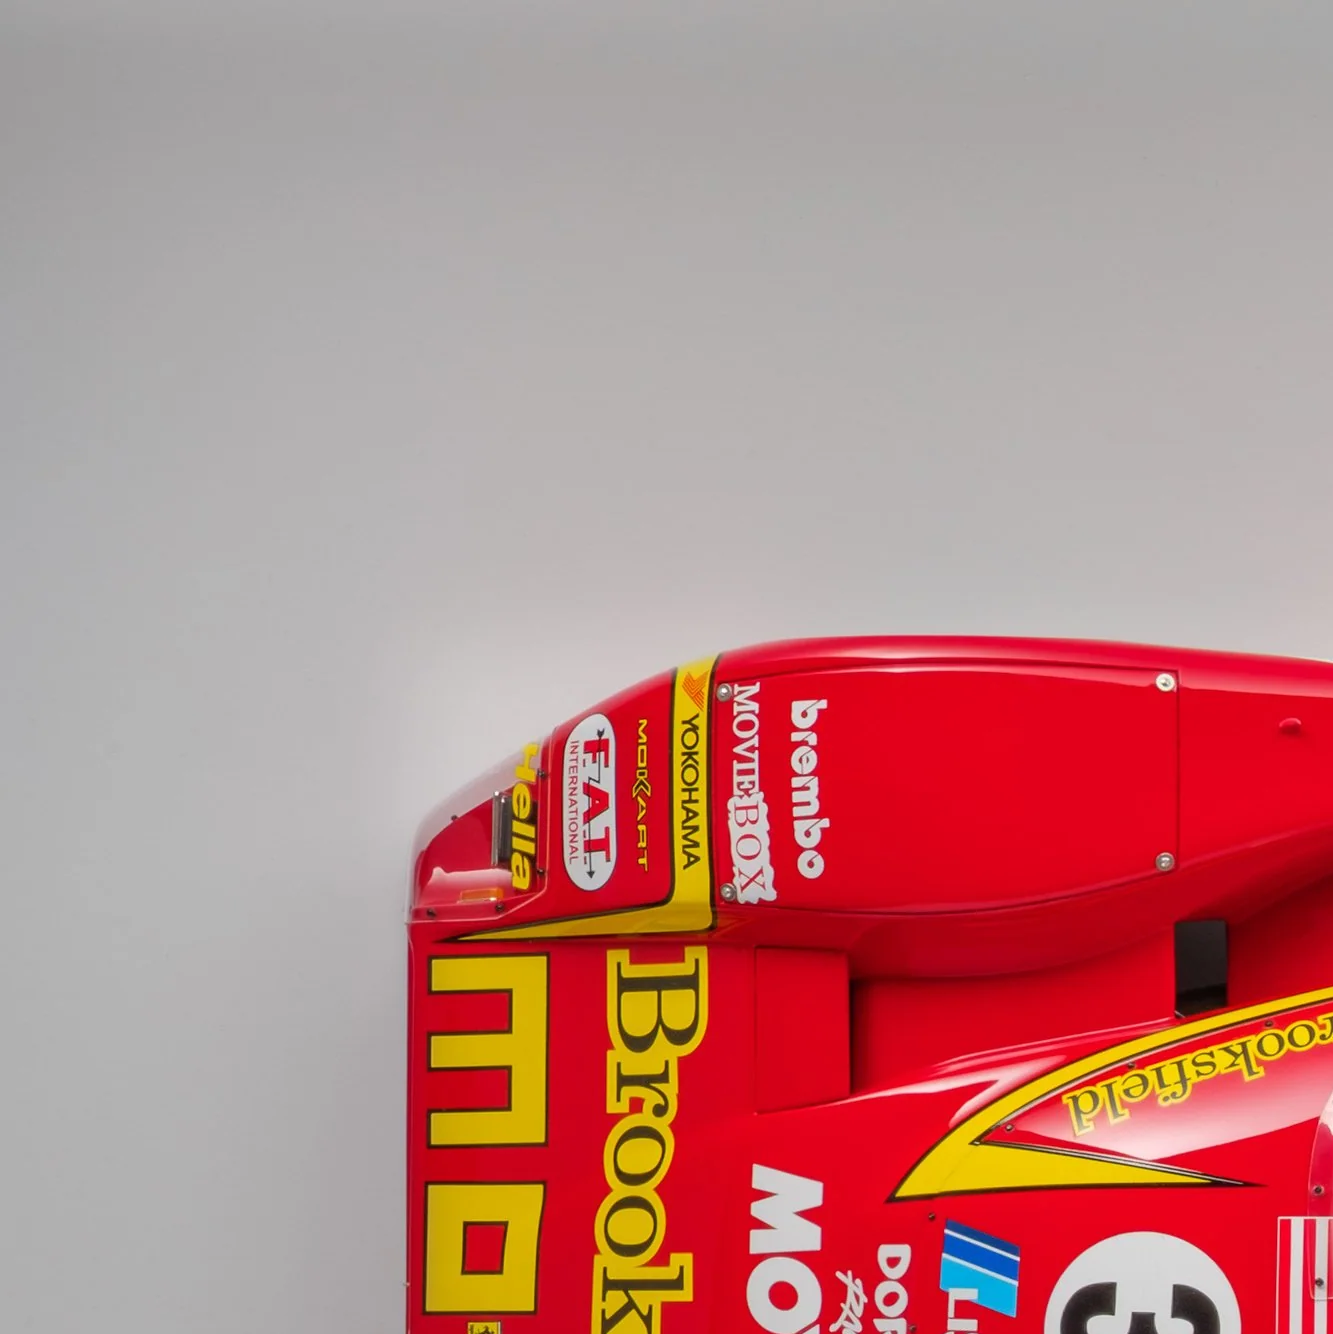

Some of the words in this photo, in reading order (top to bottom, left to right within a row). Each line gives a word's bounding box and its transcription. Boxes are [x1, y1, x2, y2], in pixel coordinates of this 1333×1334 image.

[511, 744, 539, 889] Hella
[568, 740, 579, 864] INTERNATIONAL
[632, 719, 651, 872] MOKART
[680, 713, 701, 870] YOKOHAMA
[790, 699, 830, 879] brembo
